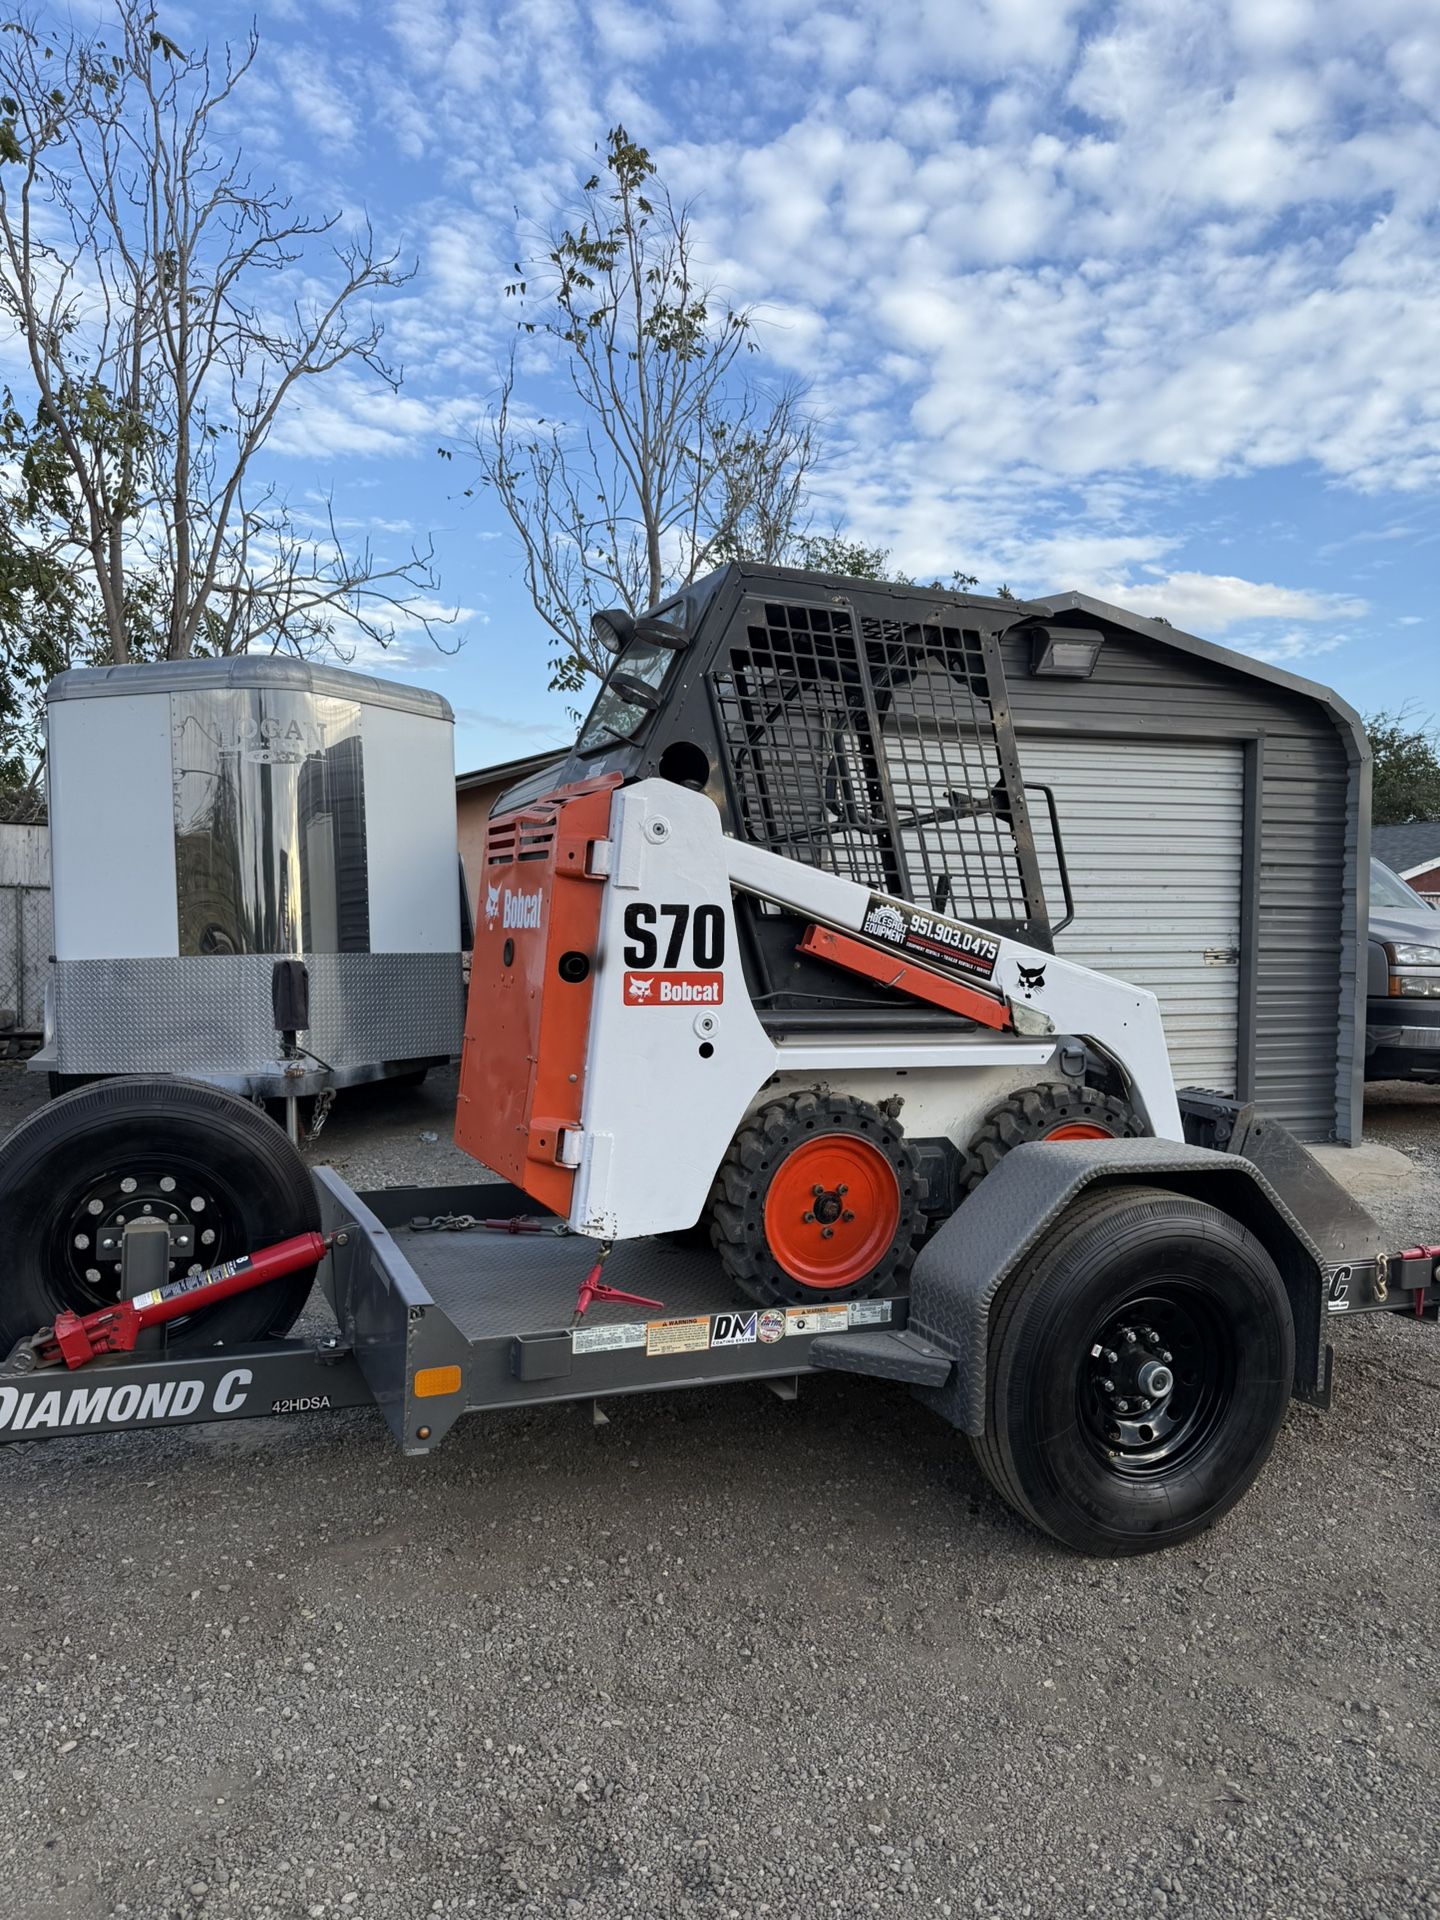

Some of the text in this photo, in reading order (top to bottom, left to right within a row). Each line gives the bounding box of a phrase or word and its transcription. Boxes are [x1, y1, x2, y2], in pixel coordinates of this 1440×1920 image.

[503, 887, 543, 929] Bobcat
[863, 921, 906, 944] EQUIPMENT
[866, 911, 909, 934] HOLESHOT
[624, 902, 725, 970] S70
[909, 914, 998, 960] 951.903.0475
[660, 981, 719, 1002] Bobcat
[668, 1318, 698, 1327] WARNING
[713, 1315, 757, 1340] DM
[212, 1368, 253, 1413] C
[272, 1396, 331, 1413] 42HDSA
